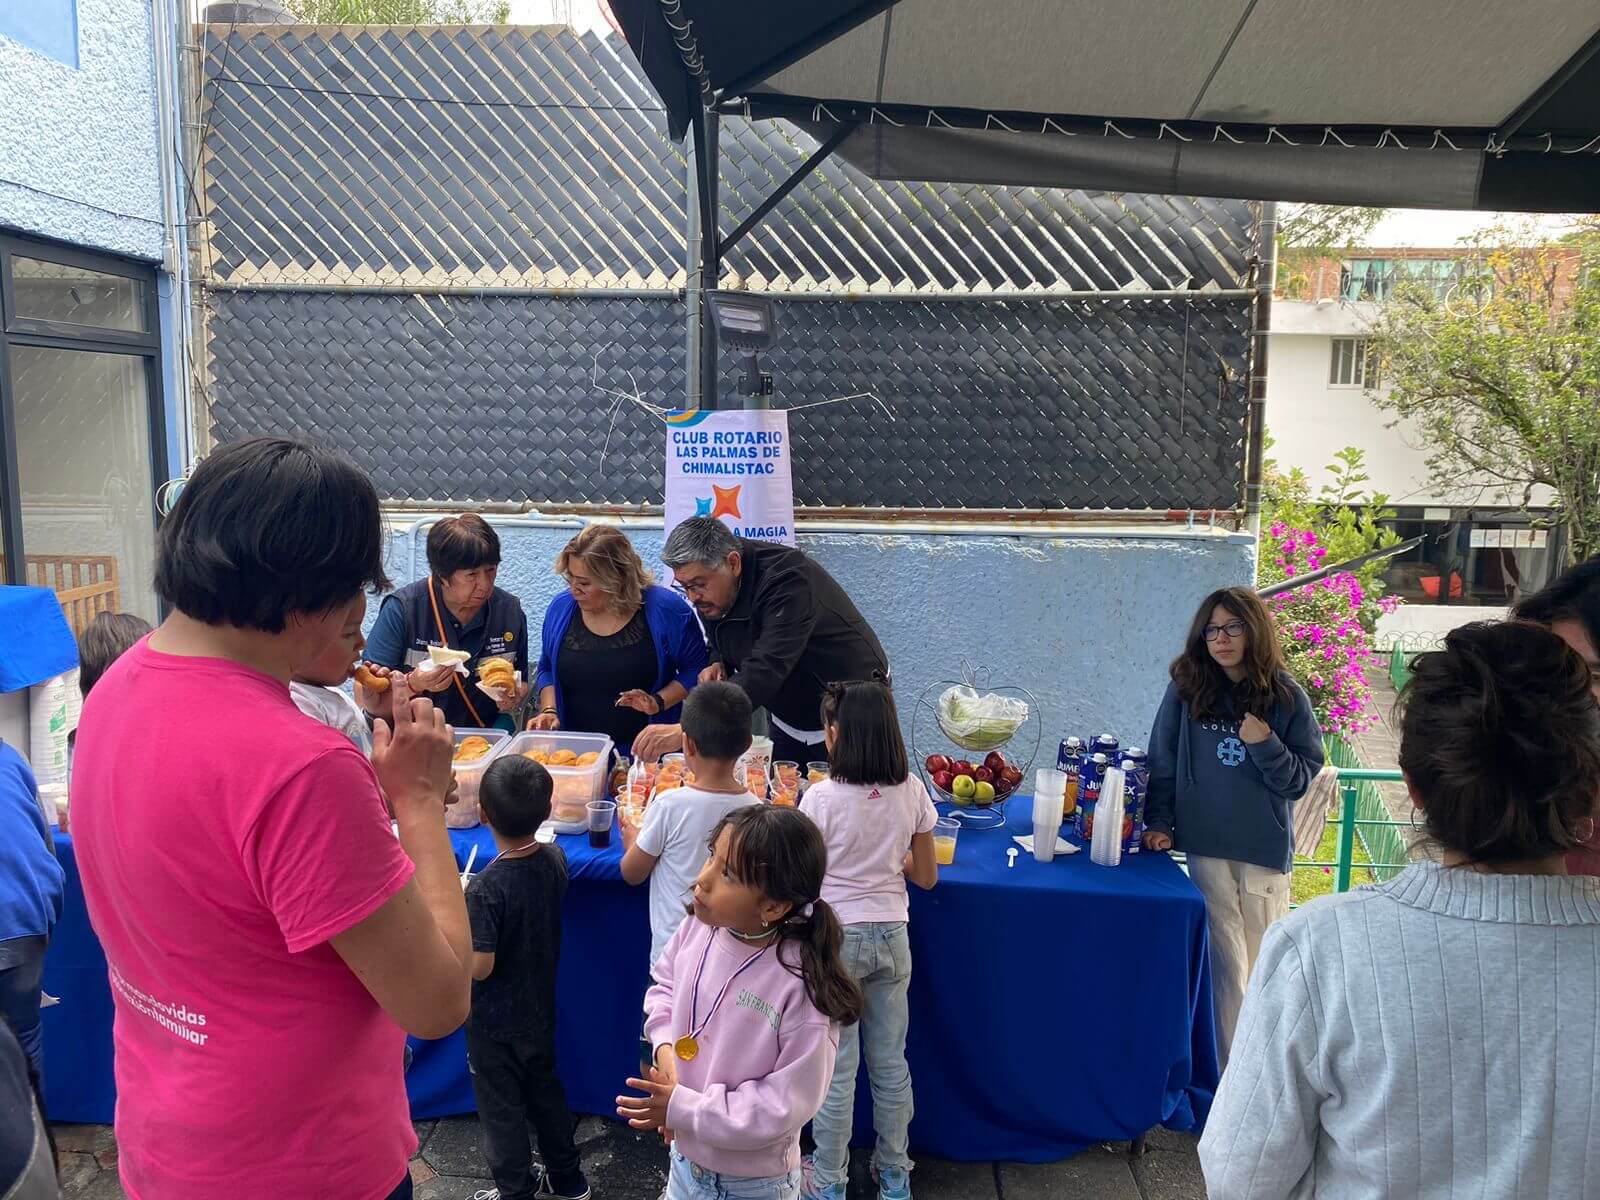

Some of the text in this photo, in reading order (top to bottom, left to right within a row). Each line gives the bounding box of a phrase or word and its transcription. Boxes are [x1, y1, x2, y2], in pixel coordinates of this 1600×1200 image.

[673, 431, 782, 444] CLUB ROTARIO
[677, 446, 780, 458] LAS PALMAS DE
[682, 462, 774, 474] CHIMALISTAC
[745, 526, 787, 538] MAGIA
[1057, 760, 1080, 773] JUME
